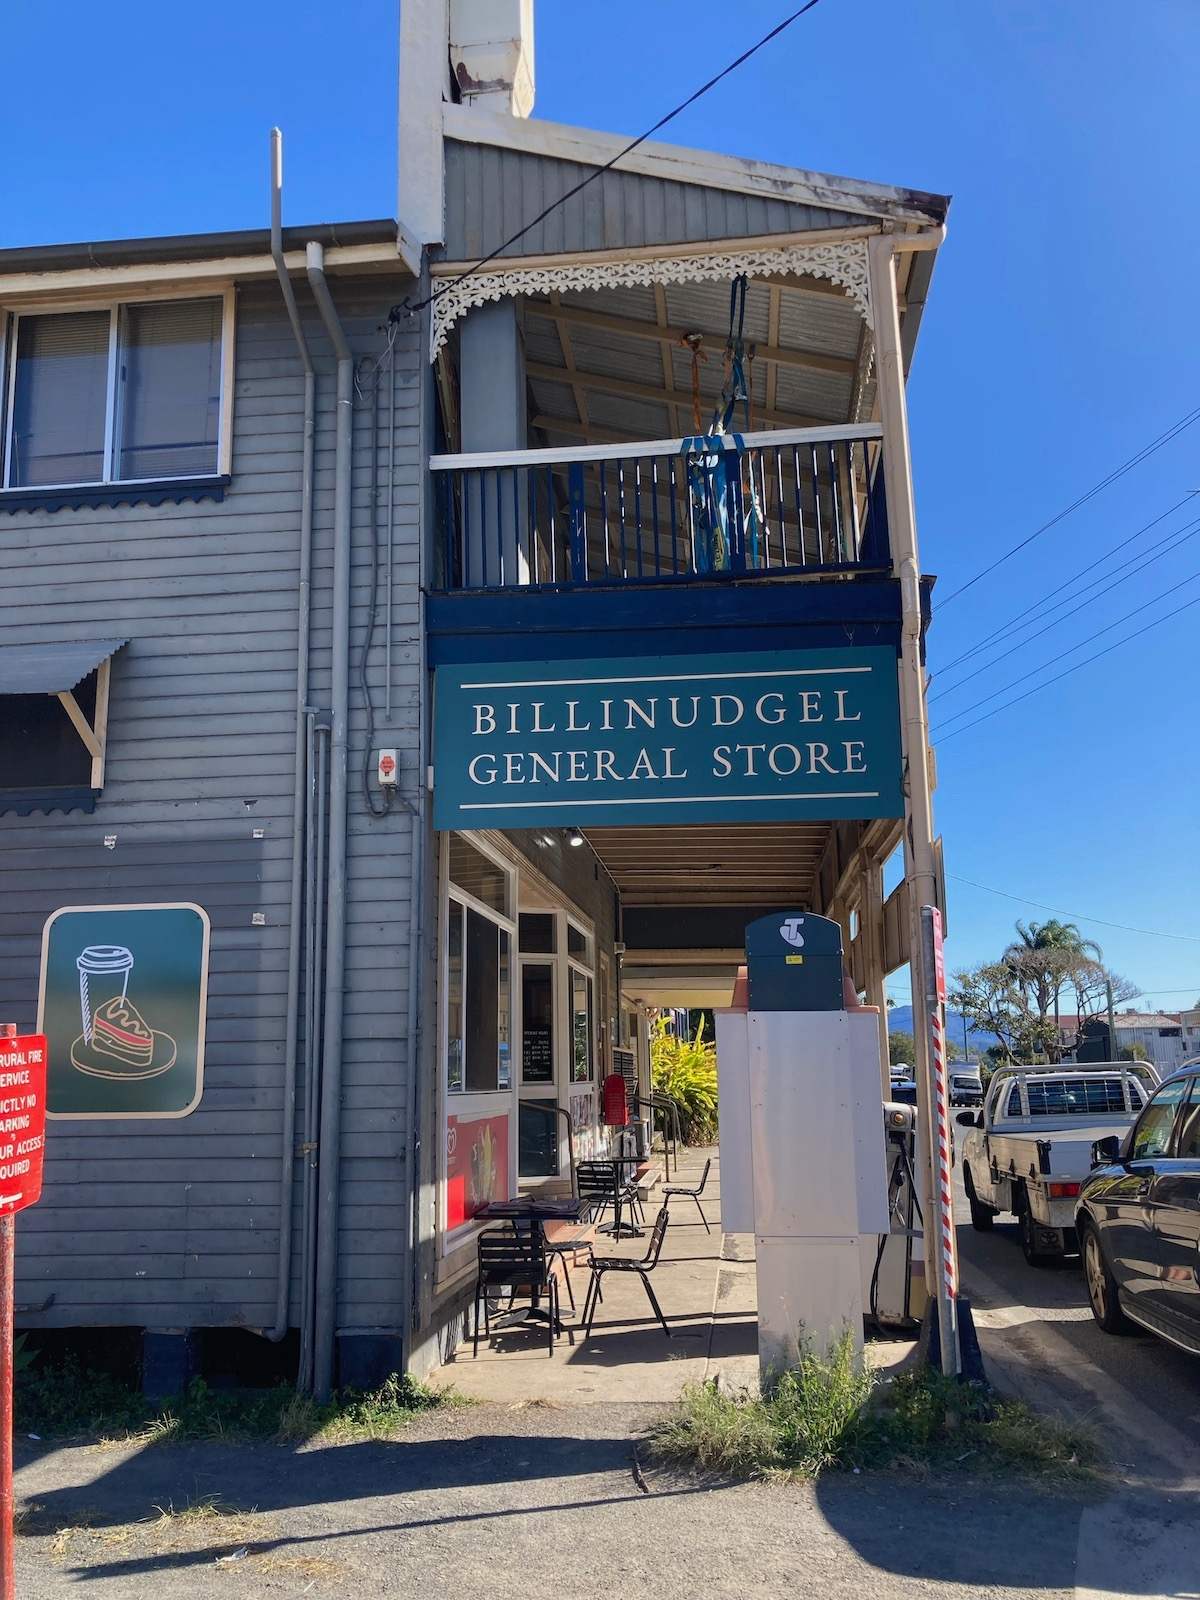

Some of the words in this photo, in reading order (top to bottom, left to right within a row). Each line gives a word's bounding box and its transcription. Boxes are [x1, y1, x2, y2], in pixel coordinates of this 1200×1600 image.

[472, 690, 862, 735] BILLINUDGEL
[468, 747, 688, 786] GENERAL
[711, 741, 868, 778] STORE
[0, 1051, 27, 1067] RURAL
[28, 1049, 43, 1064] FIRE
[0, 1070, 30, 1088] ERVICE
[0, 1095, 26, 1114] ICTLY
[26, 1093, 37, 1108] NO
[0, 1114, 30, 1133] ARKING
[16, 1135, 42, 1156] ACCESS
[0, 1158, 30, 1180] QUIRED
